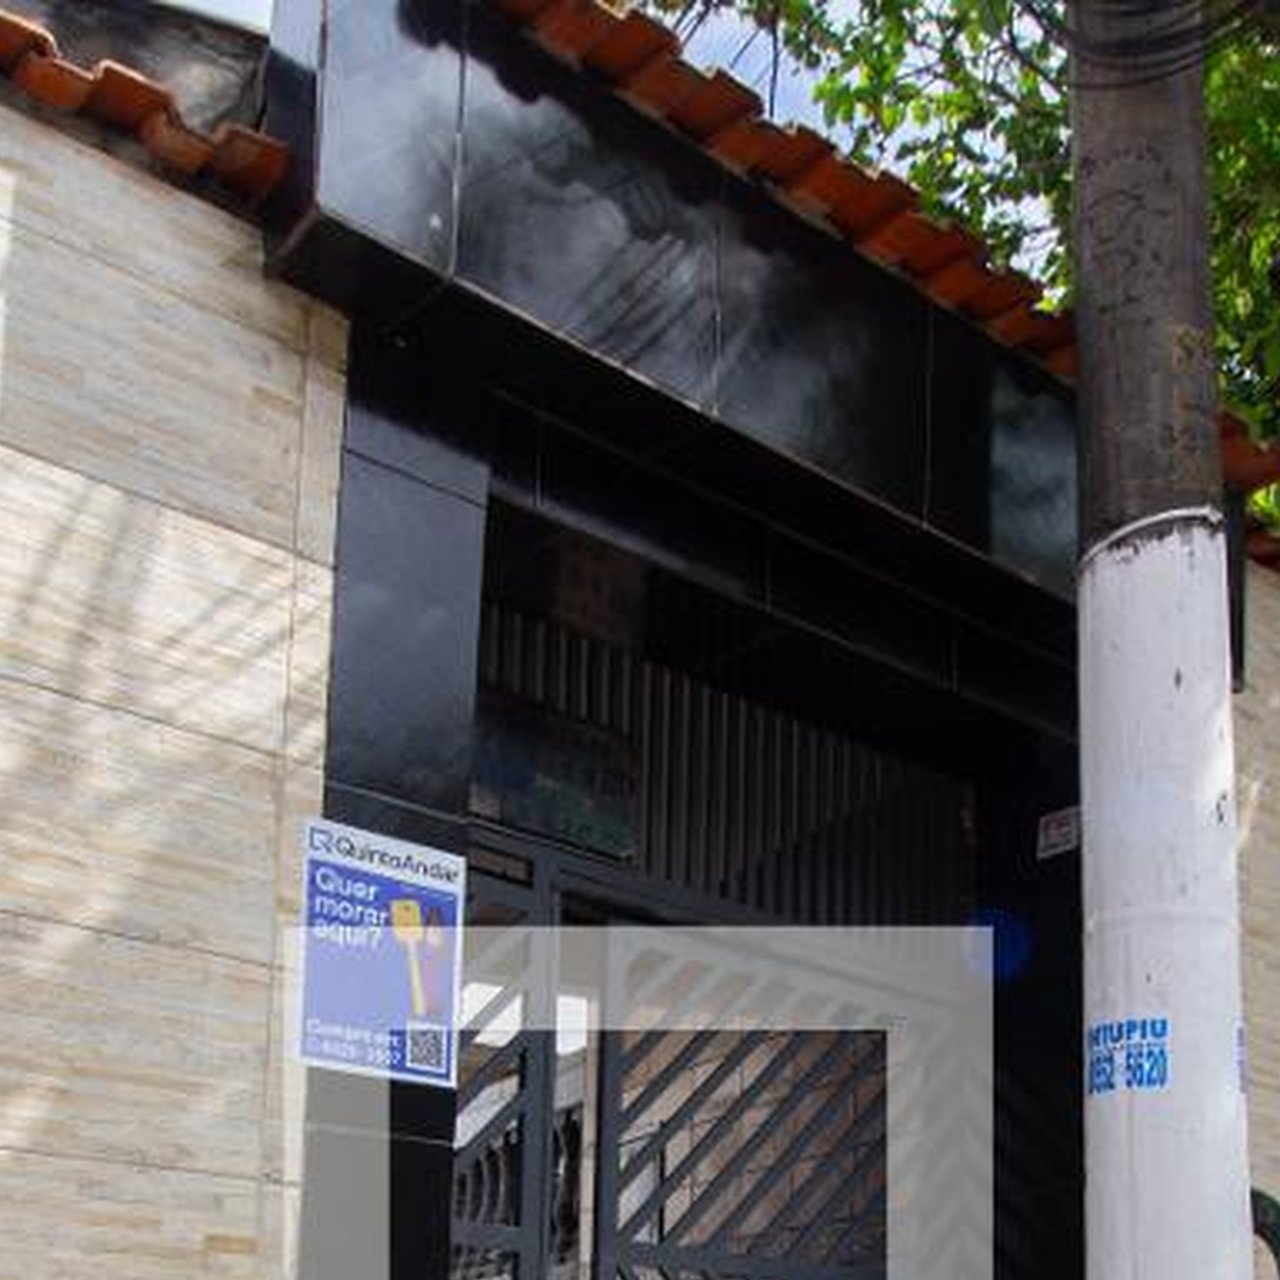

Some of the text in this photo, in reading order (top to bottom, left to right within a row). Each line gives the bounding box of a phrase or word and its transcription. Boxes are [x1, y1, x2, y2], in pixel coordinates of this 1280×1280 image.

[314, 867, 377, 901] Quer
[314, 895, 387, 926] morar
[313, 917, 381, 947] aqui?
